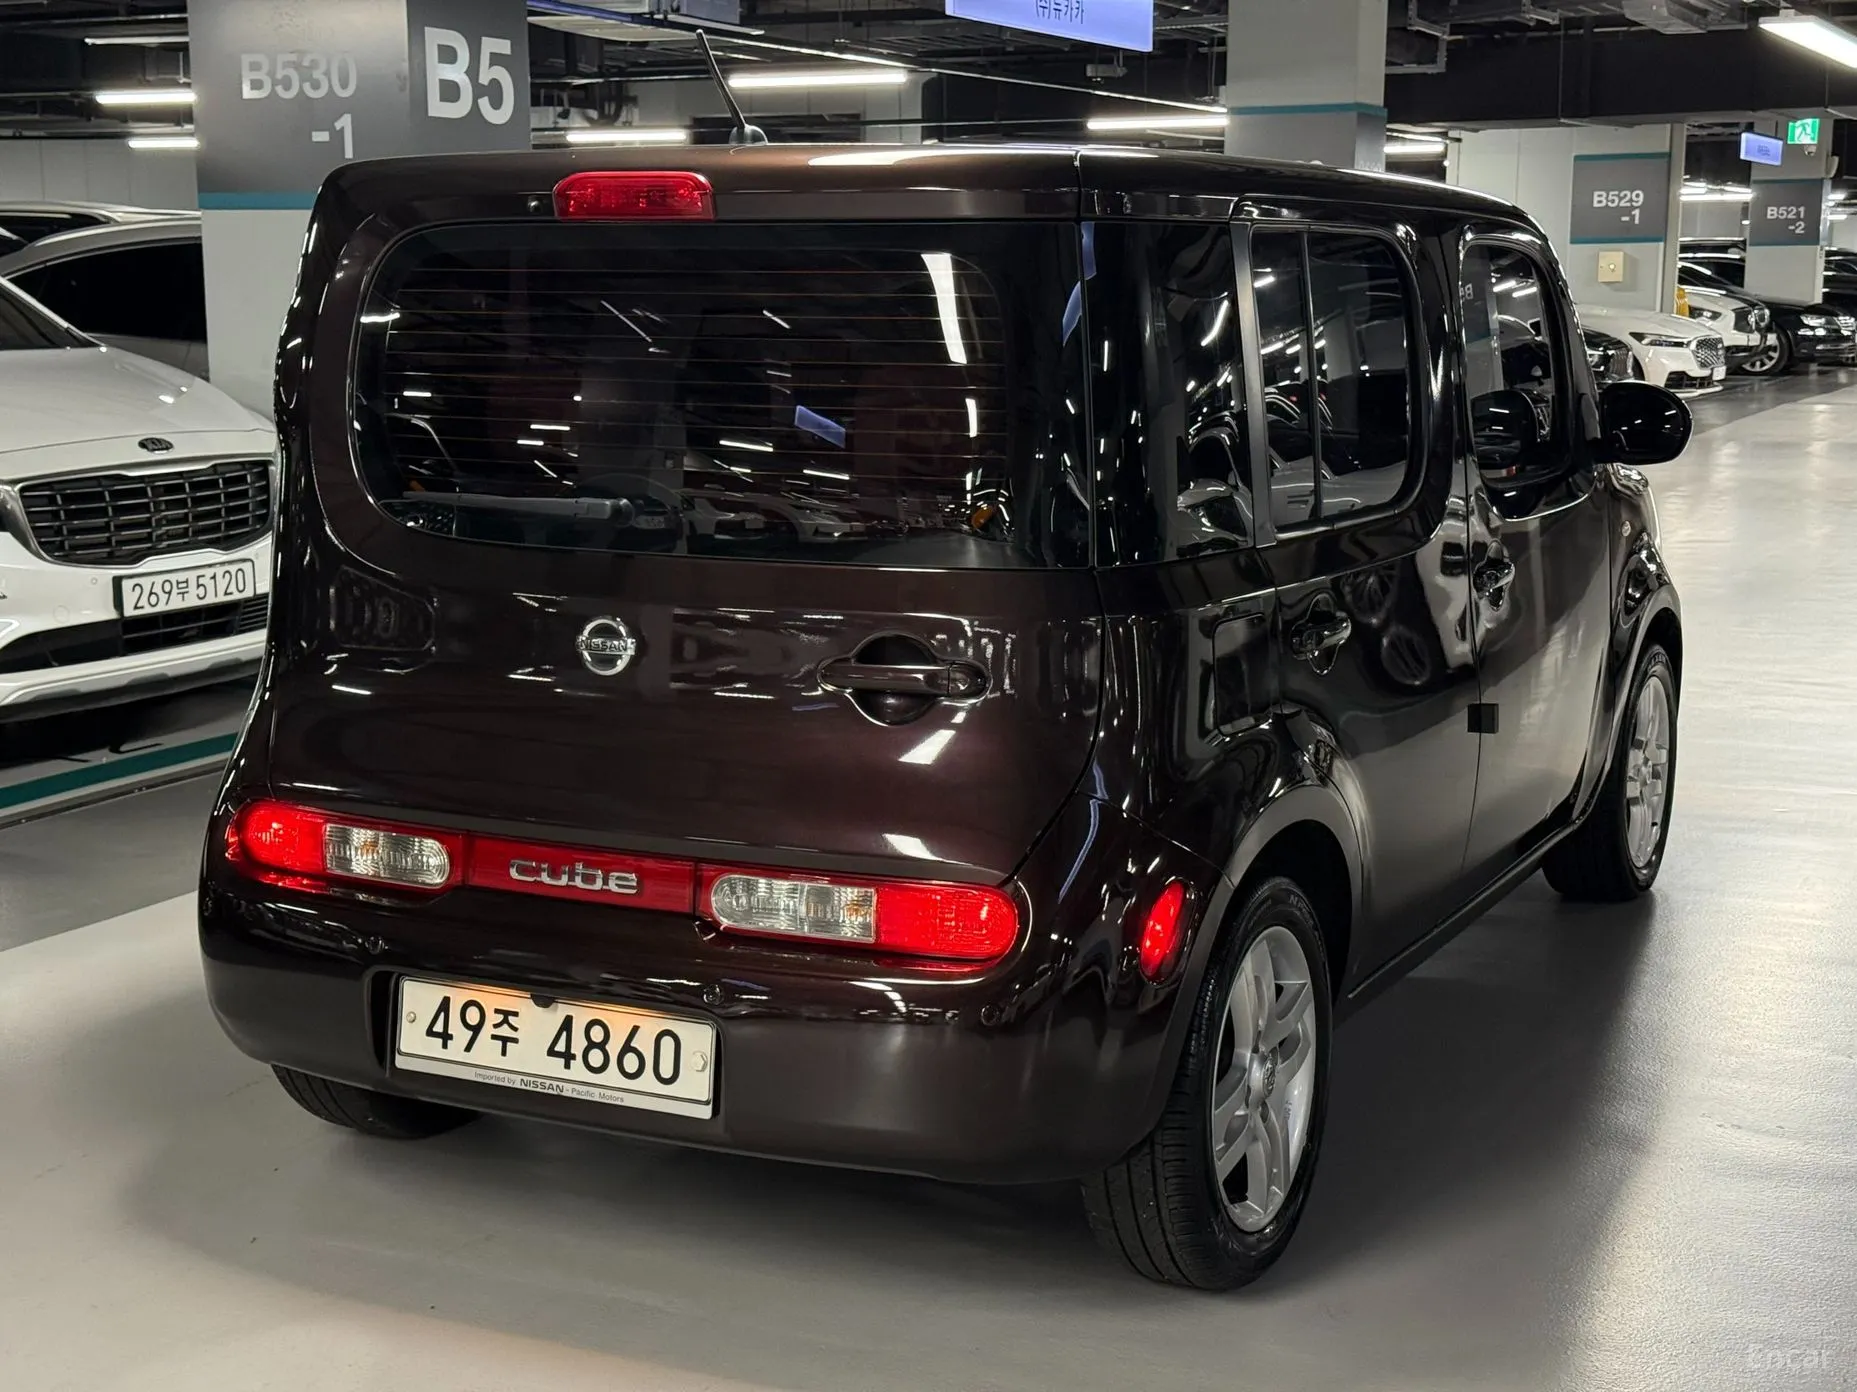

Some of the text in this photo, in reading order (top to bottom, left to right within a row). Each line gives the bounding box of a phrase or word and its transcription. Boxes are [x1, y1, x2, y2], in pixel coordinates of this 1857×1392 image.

[240, 52, 357, 100] B530
[424, 26, 515, 125] B5
[311, 113, 355, 160] -1
[1592, 189, 1645, 208] B529
[1766, 206, 1806, 219] B521
[1620, 208, 1641, 225] -1
[1788, 221, 1806, 234] -2
[579, 637, 629, 653] NISSAN
[508, 858, 639, 895] cube
[424, 995, 682, 1086] 49주 4860
[474, 1071, 506, 1083] Imported
[507, 1076, 516, 1086] by
[519, 1078, 565, 1094] NISSAN
[571, 1087, 596, 1099] Pacific
[598, 1091, 625, 1104] Motors
